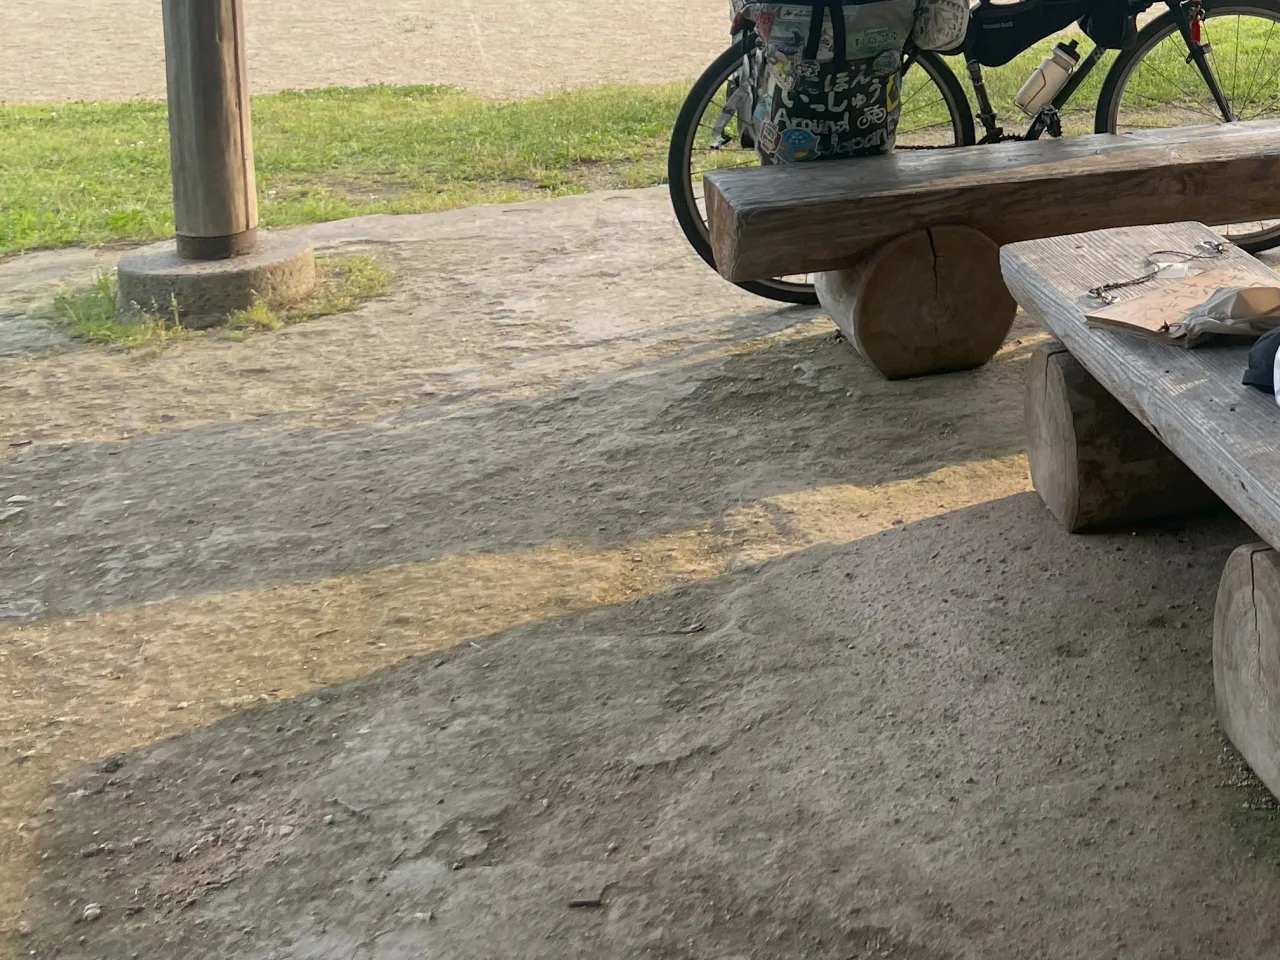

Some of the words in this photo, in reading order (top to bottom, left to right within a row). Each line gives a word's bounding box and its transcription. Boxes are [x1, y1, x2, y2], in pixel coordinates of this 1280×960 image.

[781, 78, 882, 113] いっしゅう
[773, 107, 850, 134] Around
[828, 126, 888, 156] Japan
